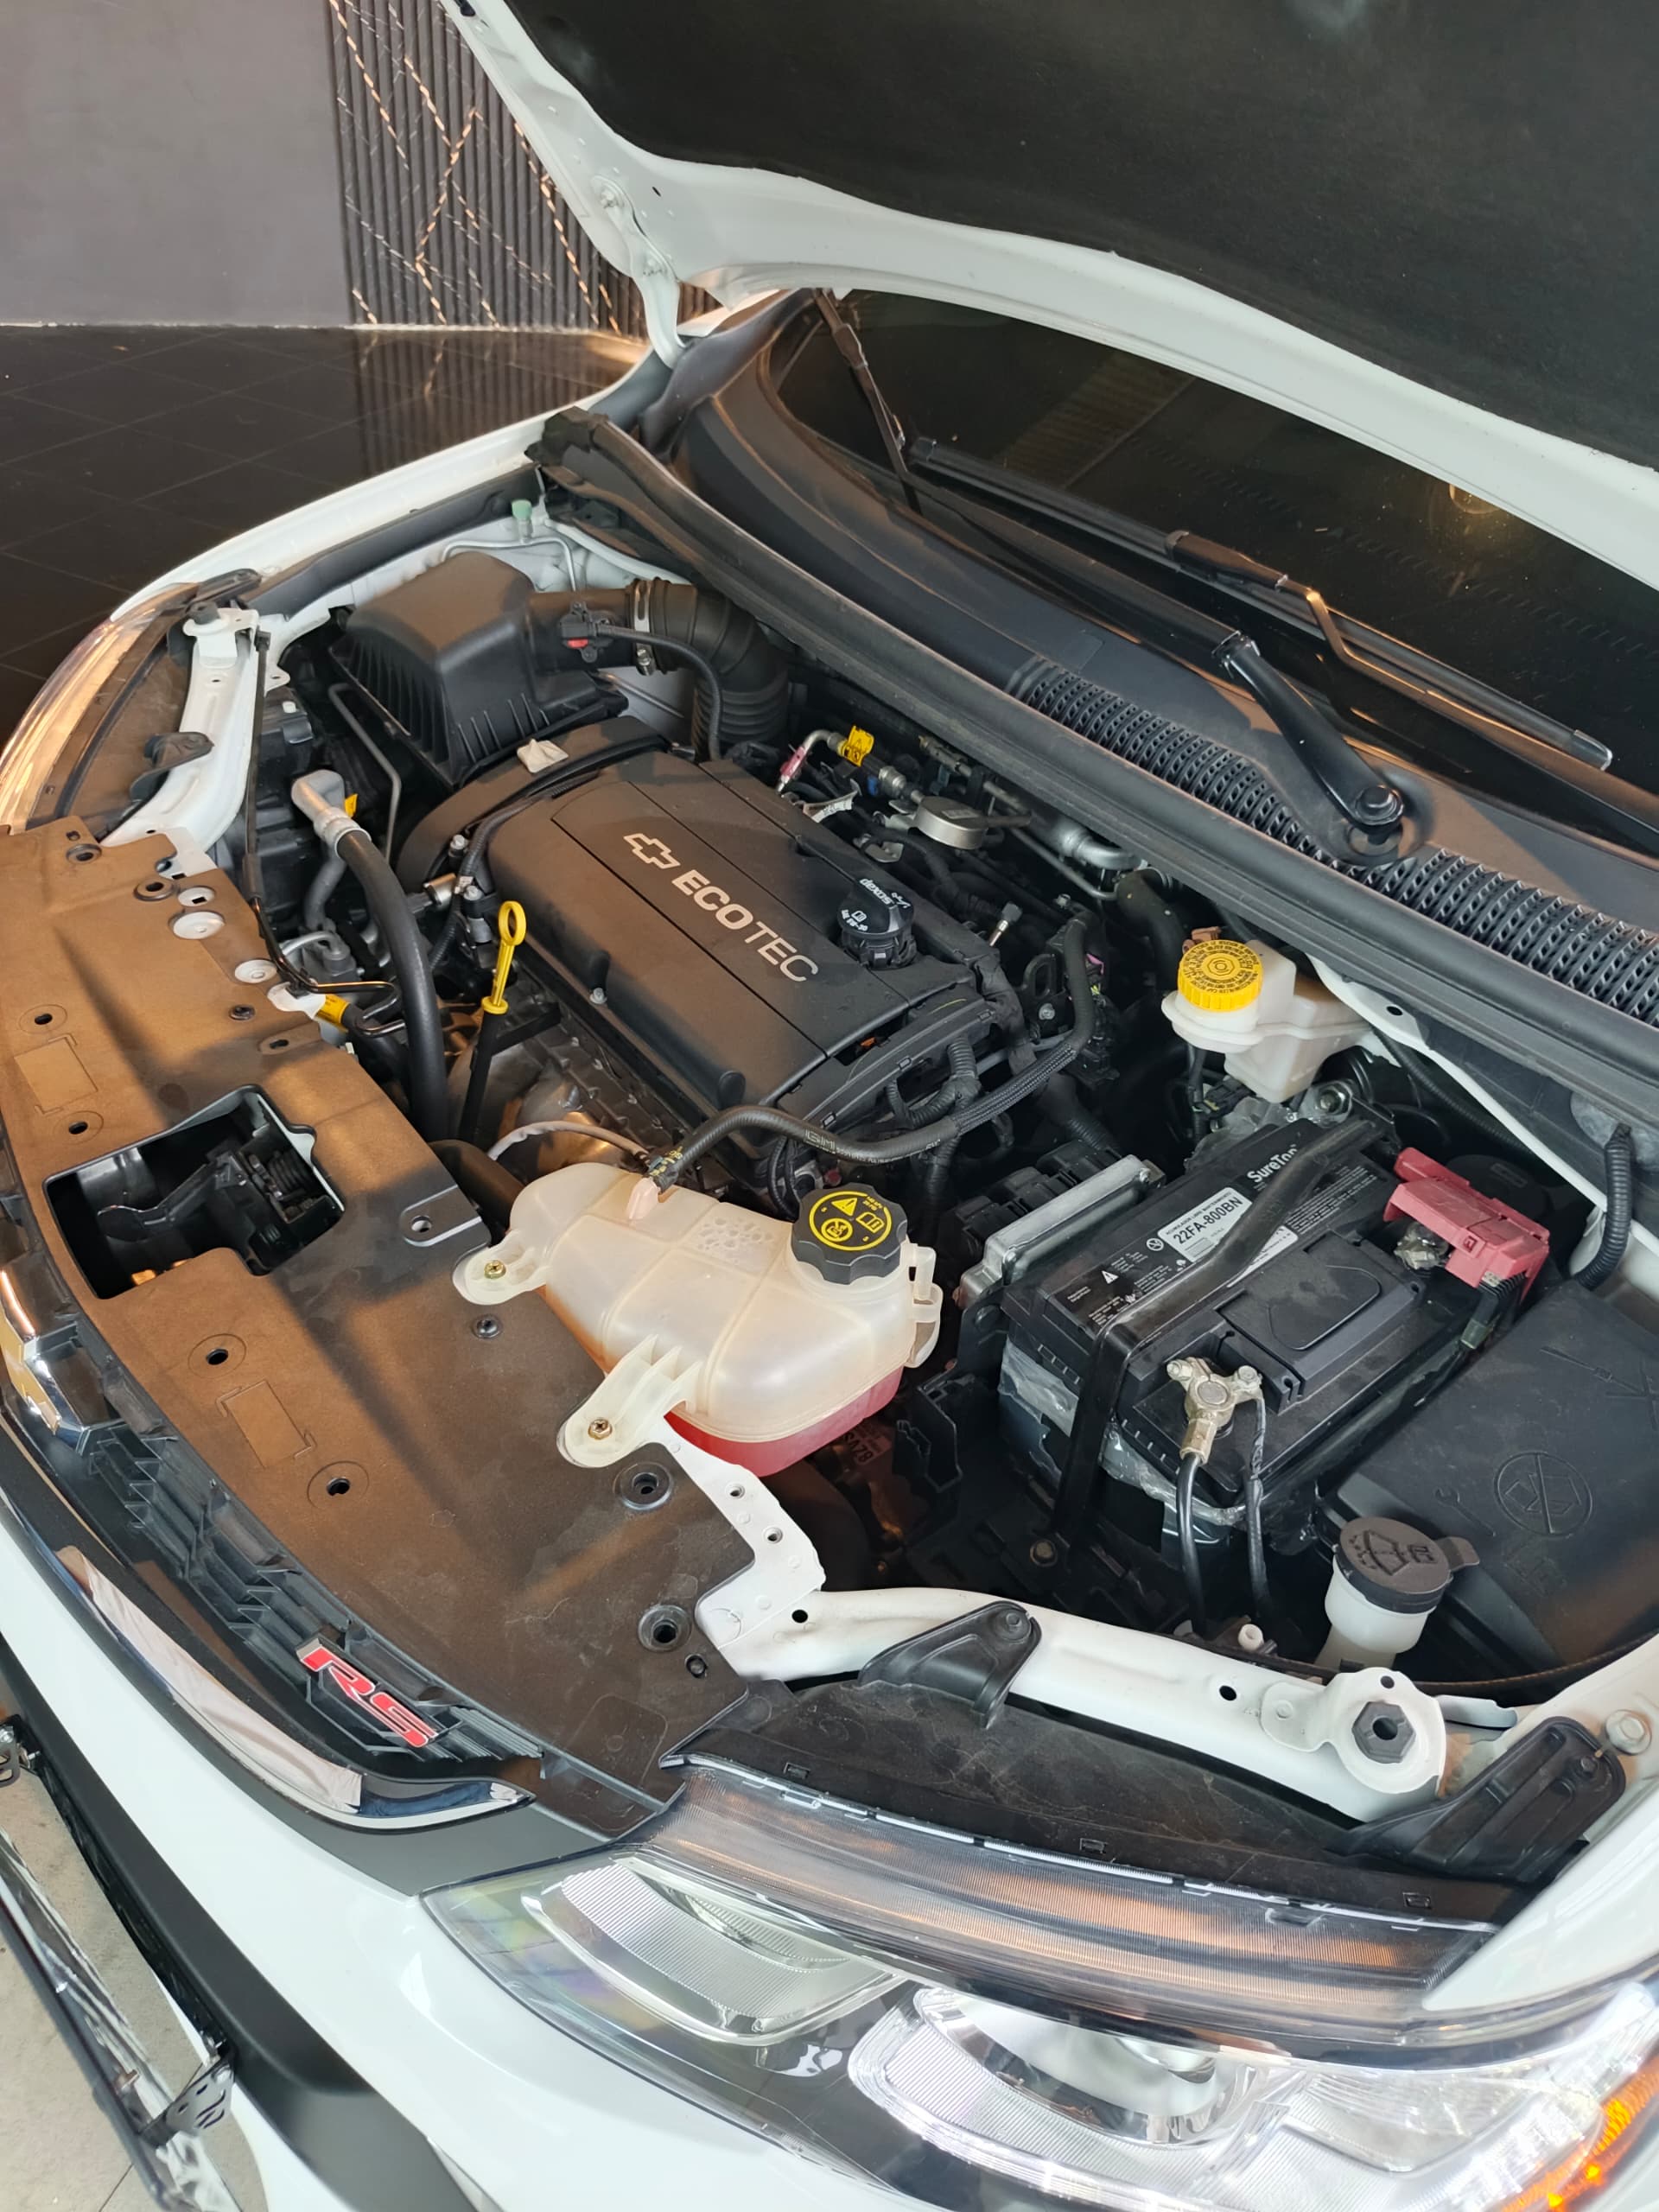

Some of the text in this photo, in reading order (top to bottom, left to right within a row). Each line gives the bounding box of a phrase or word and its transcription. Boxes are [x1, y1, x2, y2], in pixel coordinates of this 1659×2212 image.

[671, 869, 818, 982] ECOTEC
[859, 878, 893, 905] dexos
[1173, 1197, 1243, 1244] 22FA-800BN
[296, 1638, 438, 1747] RS
